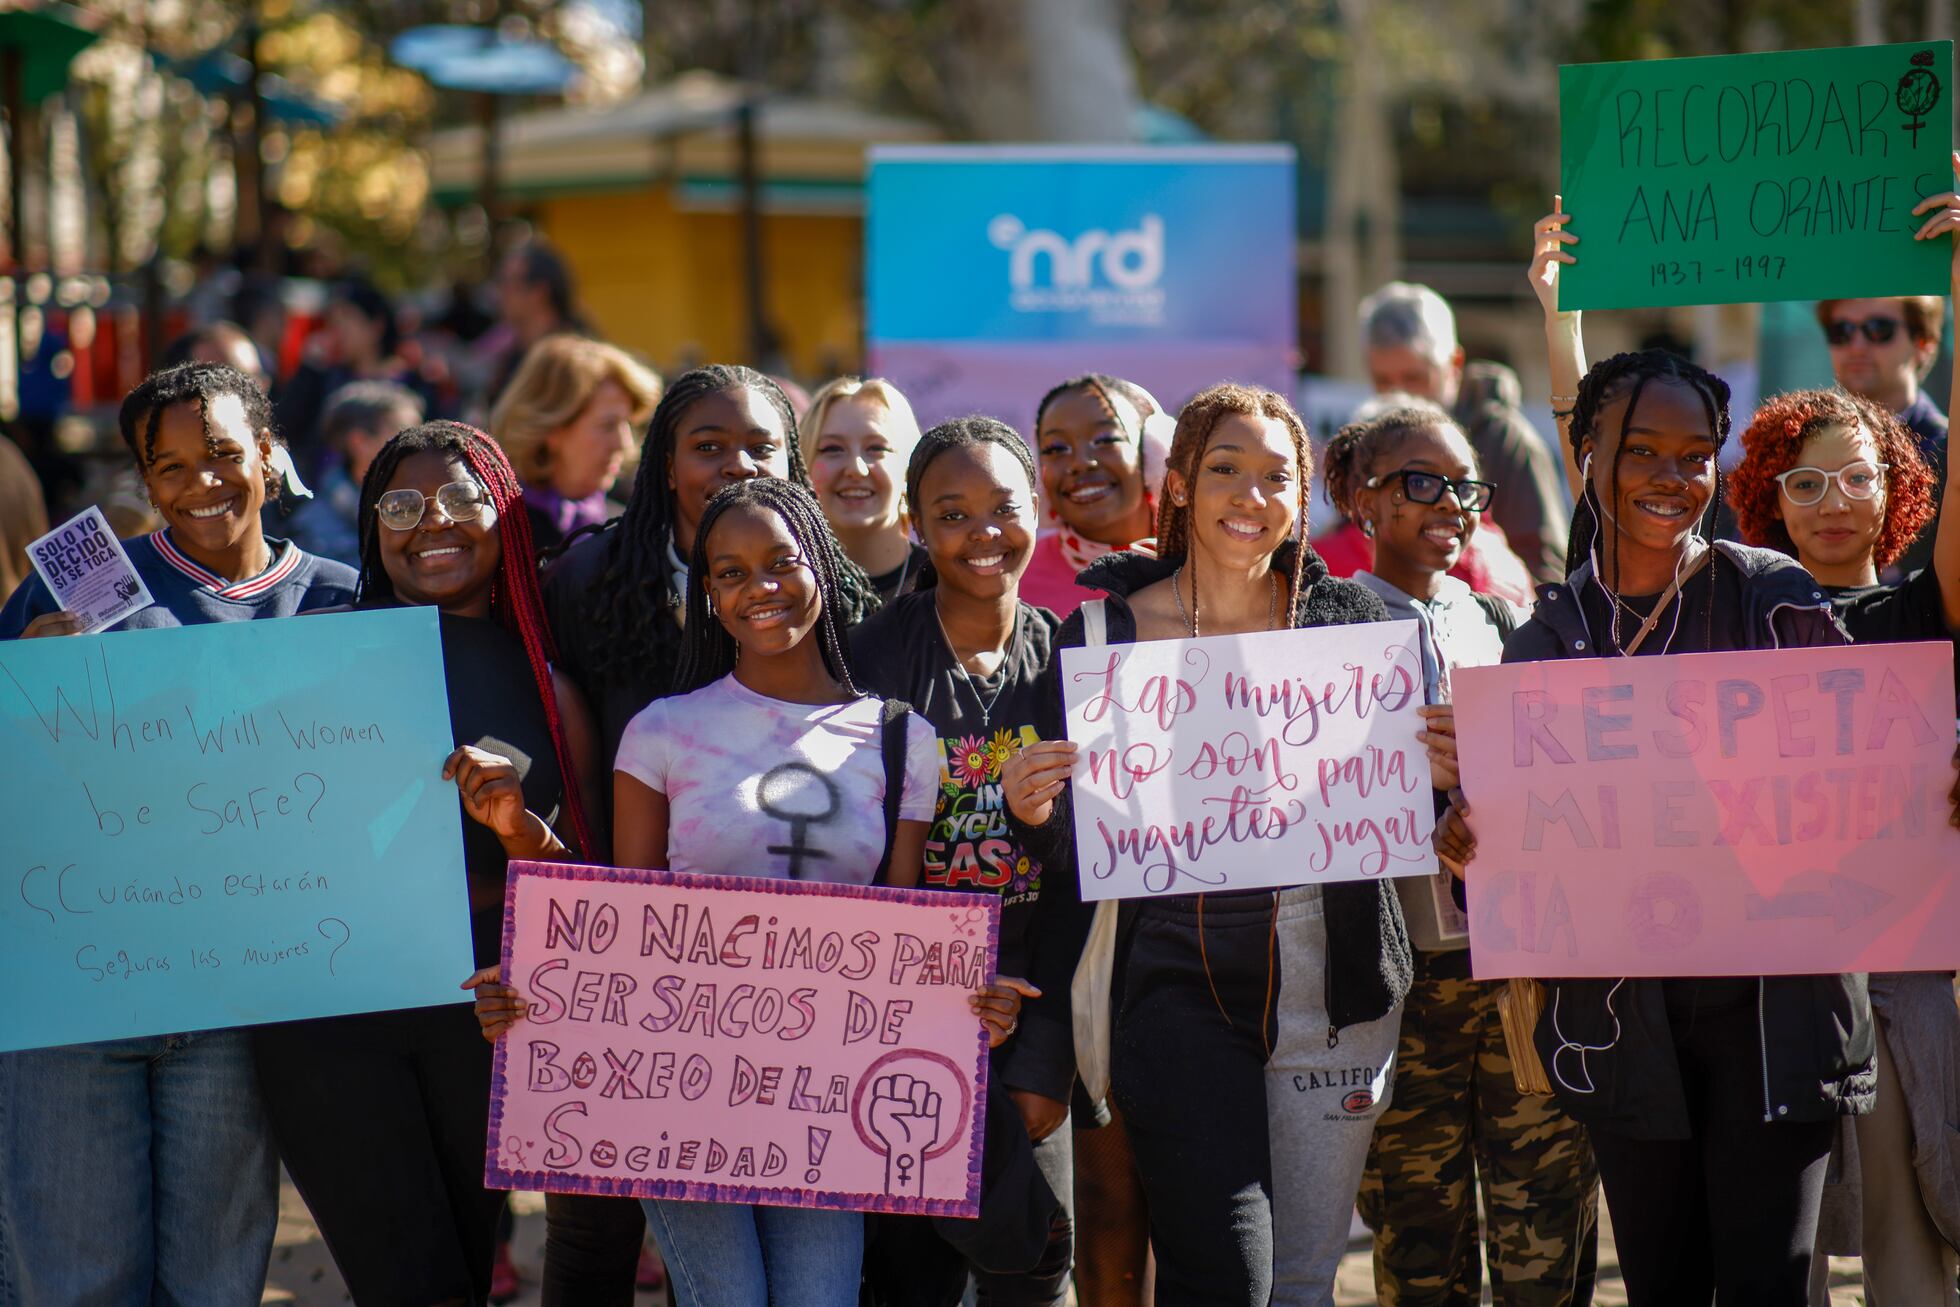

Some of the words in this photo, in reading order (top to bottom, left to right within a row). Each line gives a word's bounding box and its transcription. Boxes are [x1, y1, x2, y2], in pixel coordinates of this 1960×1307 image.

[1616, 78, 1889, 168] RECORDAR
[1618, 183, 1719, 244] ANA
[1651, 261, 1702, 287] 1937
[1735, 254, 1787, 280] 1997
[36, 530, 76, 563] SOLO
[75, 516, 99, 537] YO
[43, 530, 109, 579] DECIDO
[54, 575, 68, 589] SI
[68, 565, 85, 581] SE
[83, 548, 117, 571] TOCA
[0, 641, 174, 753] When
[185, 704, 260, 754] Will
[1074, 647, 1210, 731] Las
[1225, 644, 1421, 746] mujeres
[1512, 666, 1939, 768] RESPETA
[1089, 742, 1173, 800] no
[1178, 731, 1297, 795] son
[1317, 744, 1418, 808] para
[82, 781, 151, 837] be
[1092, 784, 1306, 893] juguetes
[1310, 806, 1430, 876] jugar
[1522, 784, 1622, 852] MI
[545, 898, 620, 956] NO
[889, 933, 987, 990] PARA
[1476, 870, 1579, 958] CIA
[75, 944, 172, 983] Seguras
[526, 958, 637, 1026] SER
[639, 974, 818, 1041] SACOS
[843, 989, 913, 1046] DE
[728, 1055, 783, 1107] DE
[788, 1065, 849, 1114] LA
